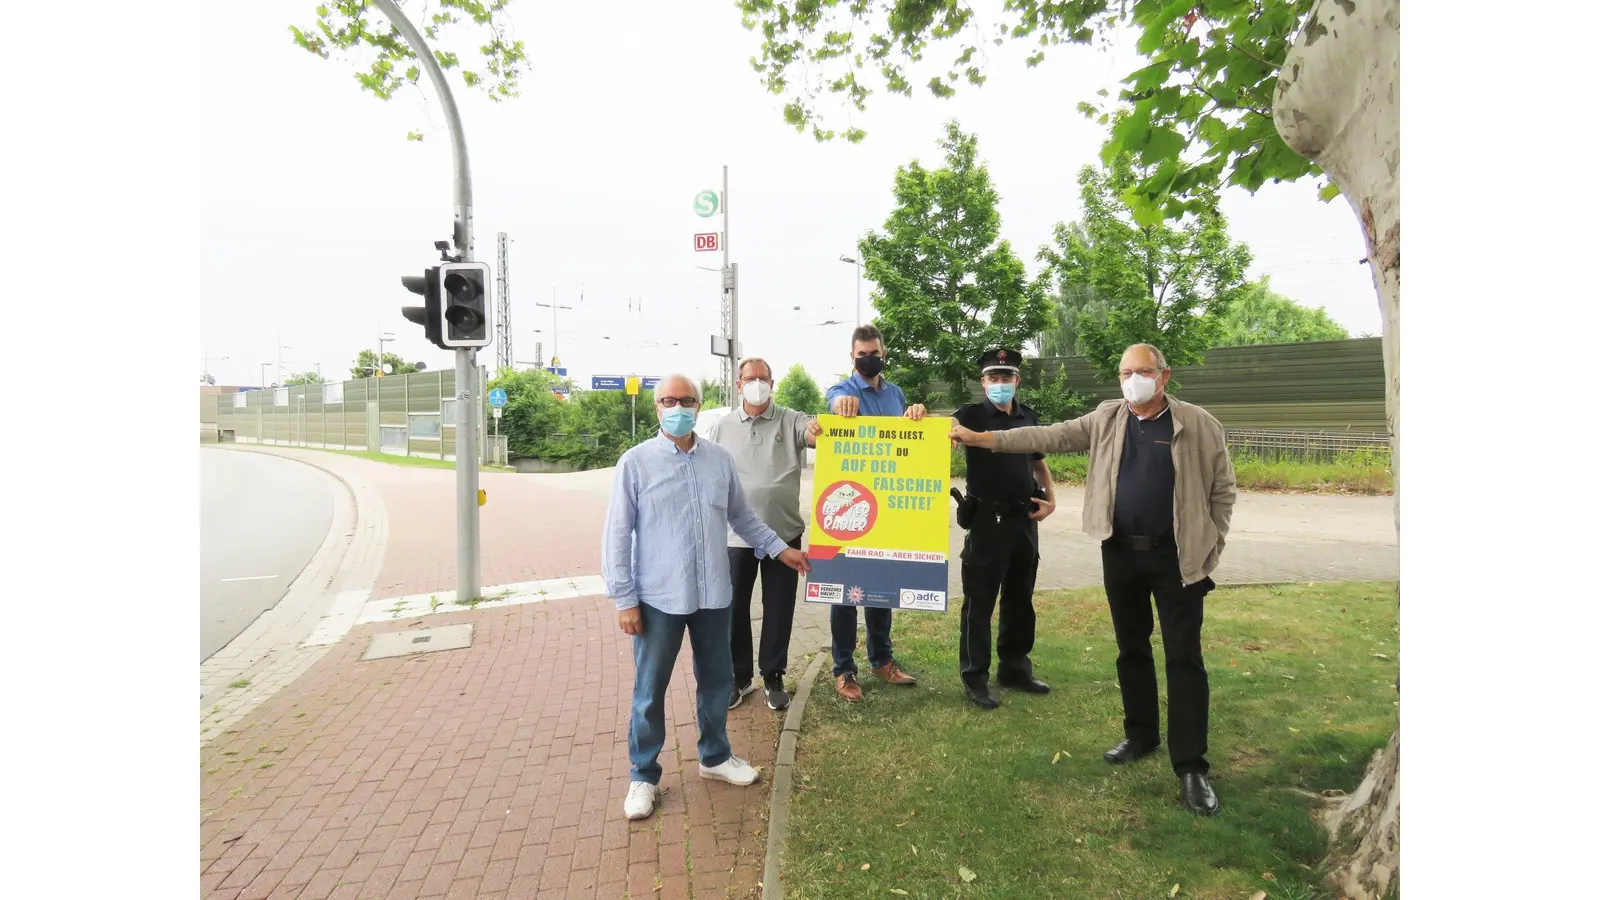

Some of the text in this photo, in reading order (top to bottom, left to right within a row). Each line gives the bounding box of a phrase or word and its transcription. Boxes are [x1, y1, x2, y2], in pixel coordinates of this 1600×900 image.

[695, 192, 714, 214] S
[697, 236, 715, 248] DB
[858, 425, 876, 438] DU
[878, 430, 897, 440] DAS
[833, 441, 909, 457] RADELST DU
[841, 459, 897, 473] AUF DER
[873, 477, 943, 493] FALSCHEN
[823, 517, 866, 532] RADLER
[914, 553, 944, 561] SICHER!
[917, 593, 939, 601] adfc
